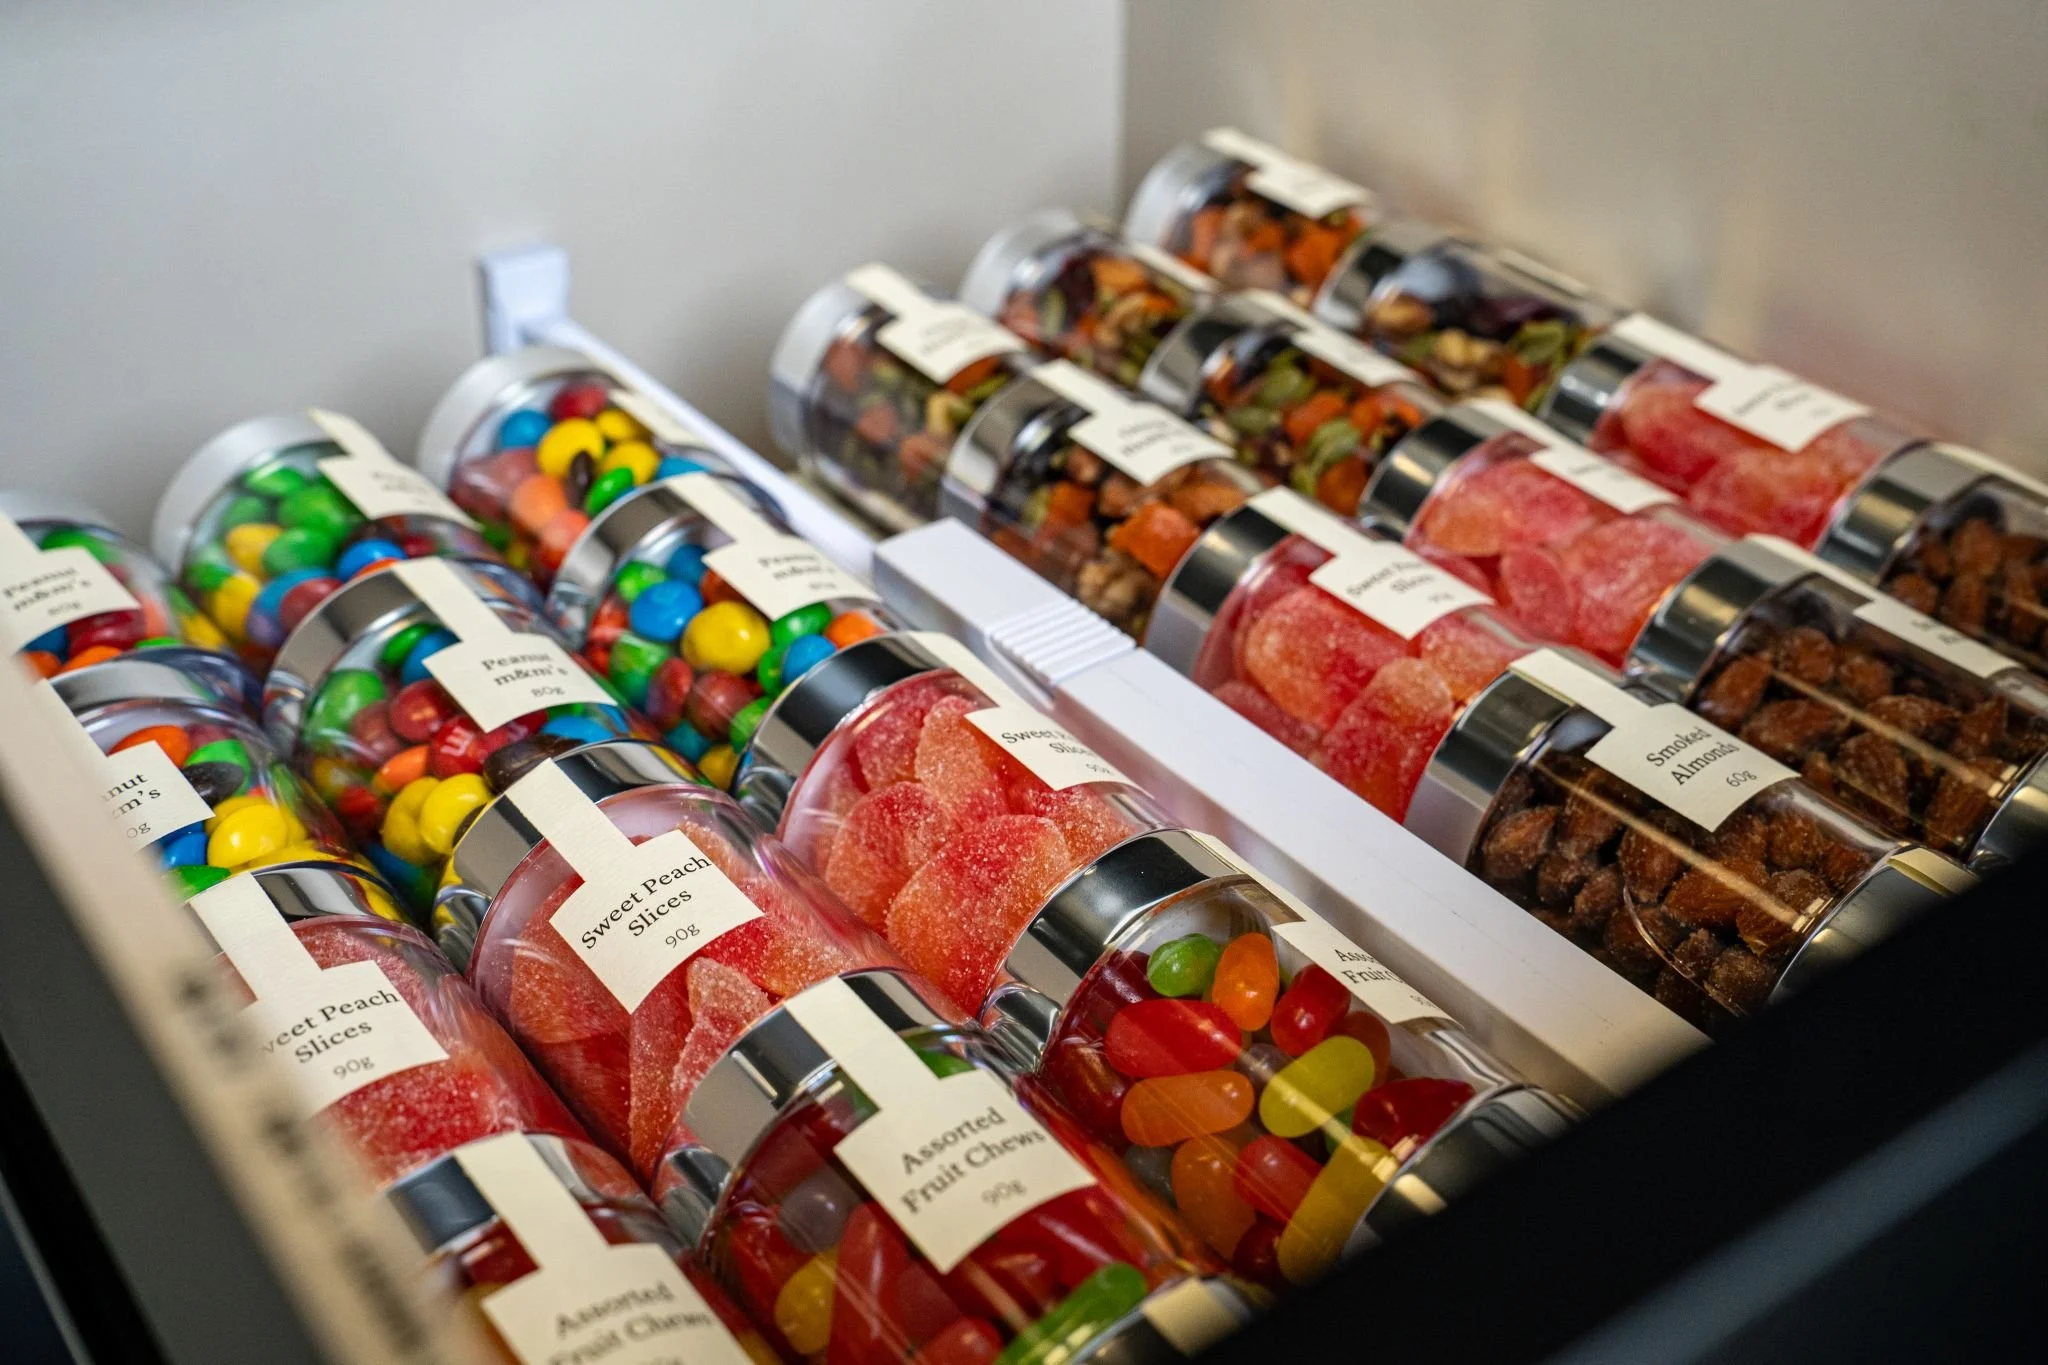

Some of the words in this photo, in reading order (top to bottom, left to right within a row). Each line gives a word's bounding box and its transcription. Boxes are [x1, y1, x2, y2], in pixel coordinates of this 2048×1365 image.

[481, 653, 552, 671] Peanut
[494, 664, 568, 685] m&m's
[530, 686, 566, 698] 80g
[1001, 729, 1054, 744] Sweet
[1646, 726, 1712, 767] Smoked
[1671, 741, 1741, 786] Almonds
[101, 774, 148, 802] nut
[1726, 770, 1758, 788] 60g
[581, 891, 644, 950] Sweet
[641, 856, 713, 895] Peach
[628, 890, 692, 937] Slices
[665, 923, 701, 949] 90g
[1340, 967, 1386, 984] Fruit
[318, 990, 400, 1022] Peach
[294, 1021, 373, 1064] Slices
[333, 1056, 375, 1080] 90g
[902, 1105, 1007, 1177] Assorted
[901, 1163, 967, 1215] Fruit
[964, 1129, 1047, 1168] Chews
[556, 1280, 677, 1341] Assorted
